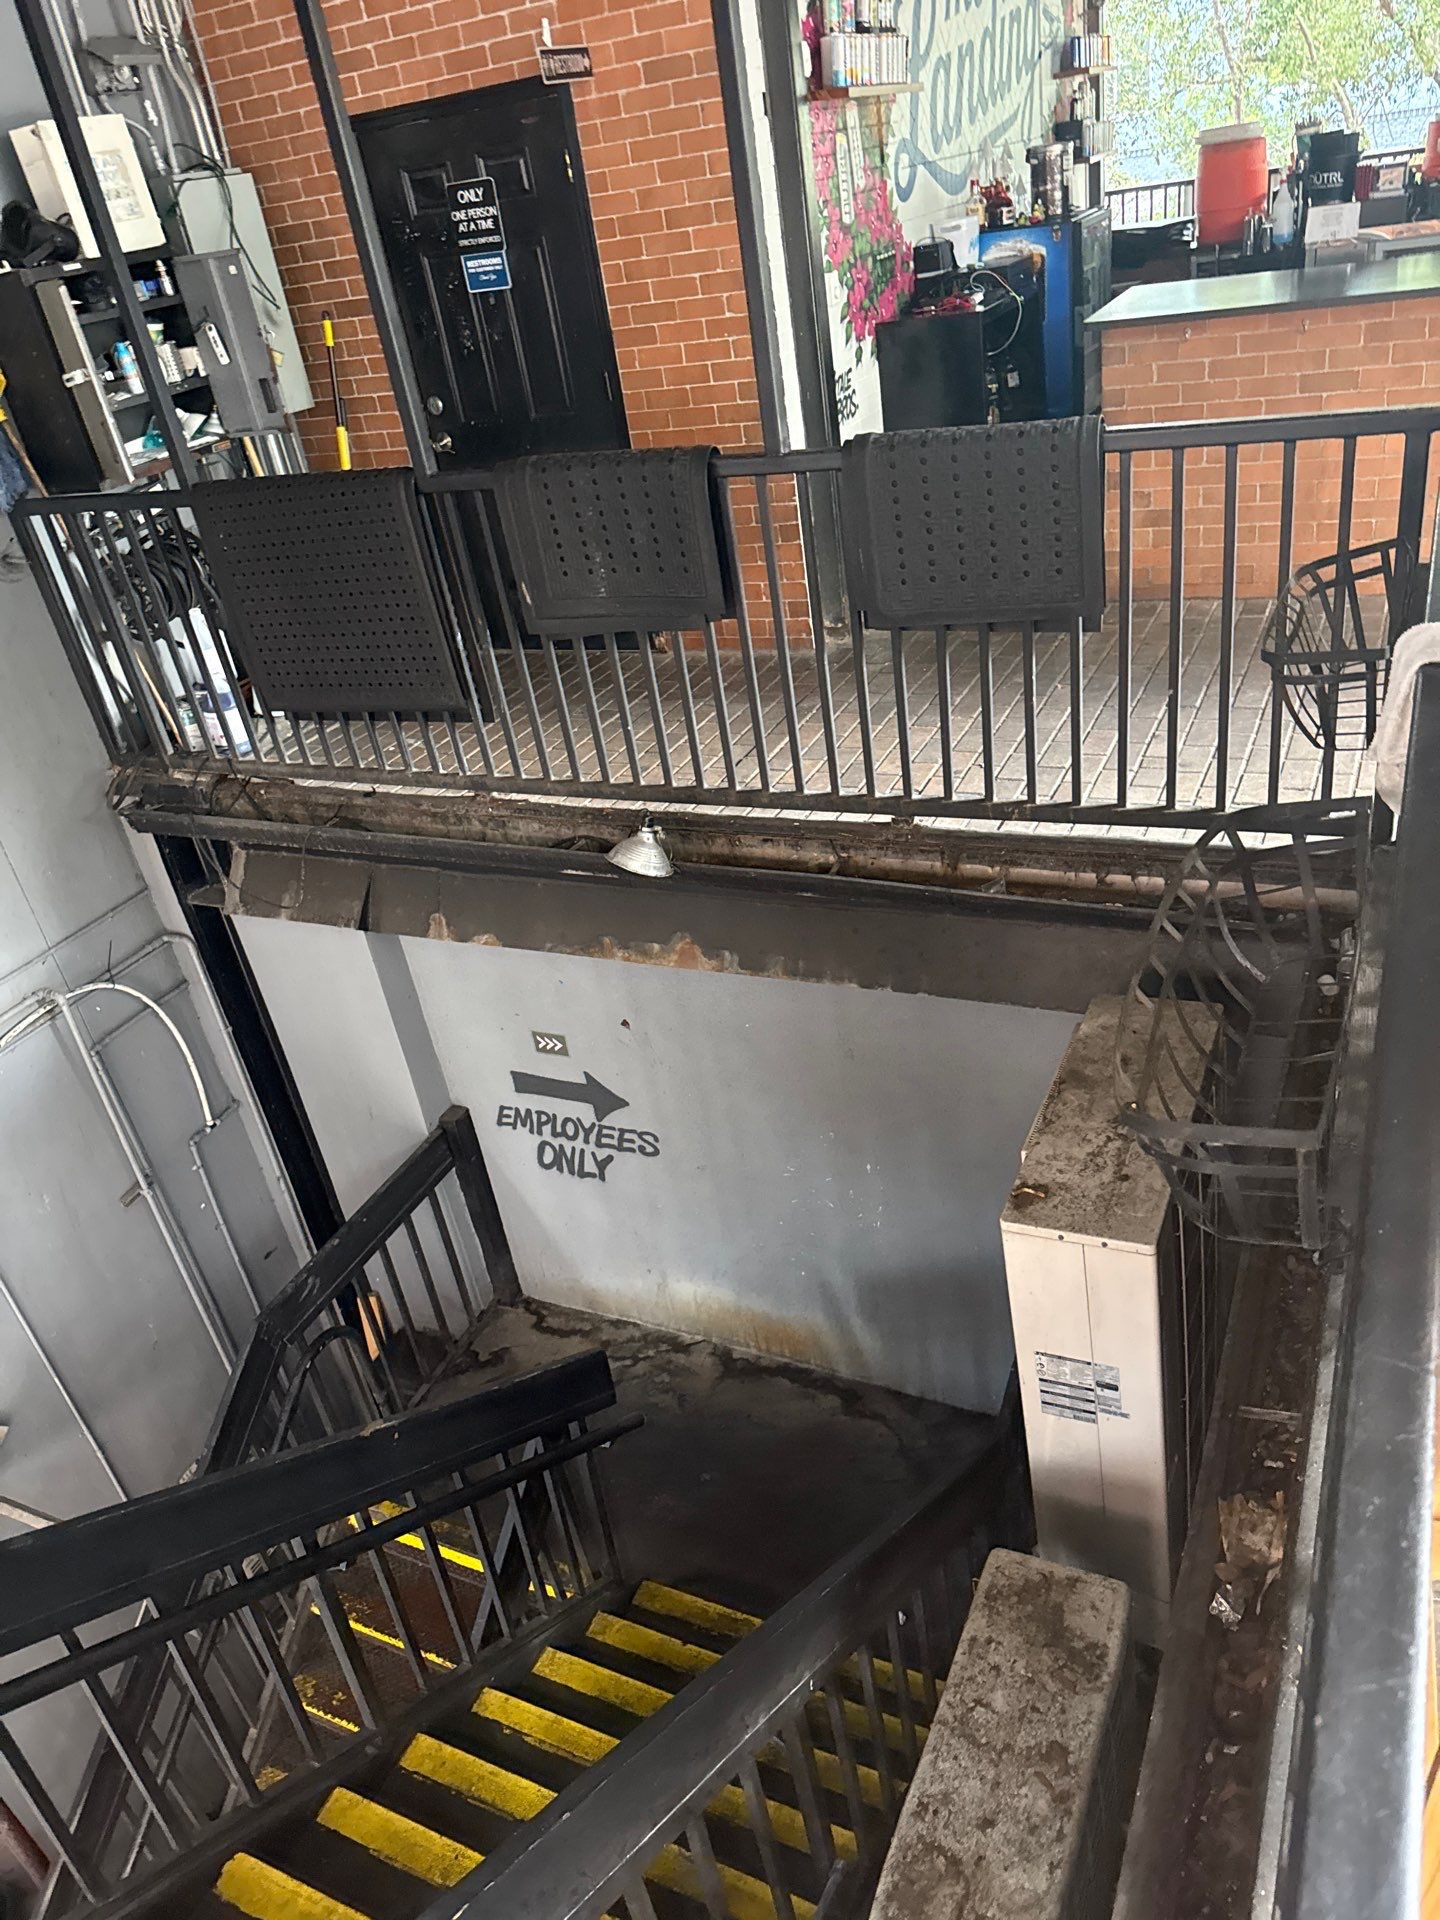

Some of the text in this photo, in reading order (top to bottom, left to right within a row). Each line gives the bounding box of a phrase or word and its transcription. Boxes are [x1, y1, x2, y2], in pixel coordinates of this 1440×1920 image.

[457, 187, 484, 204] ONLY
[451, 206, 498, 222] ONE PERSON
[458, 219, 496, 234] AT A TIME
[497, 1105, 660, 1157] EMPLOYEES
[536, 1139, 615, 1182] ONLY
